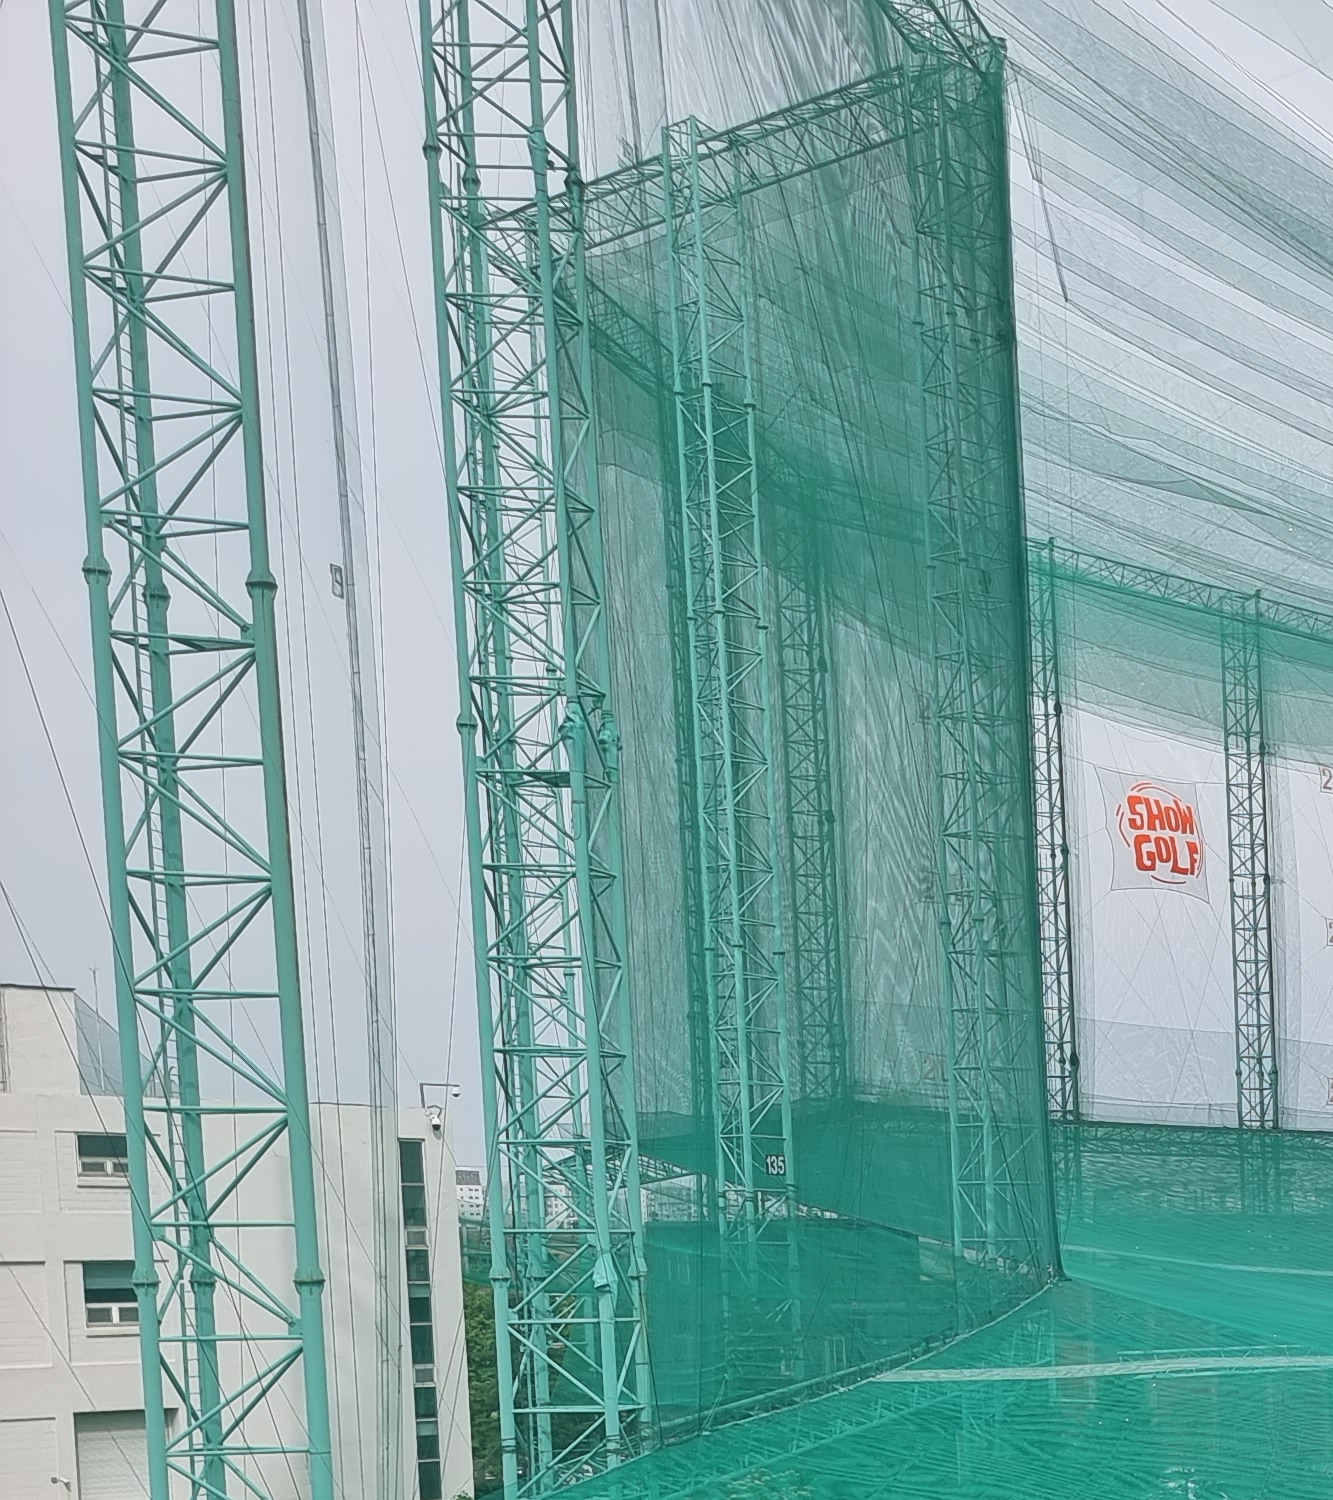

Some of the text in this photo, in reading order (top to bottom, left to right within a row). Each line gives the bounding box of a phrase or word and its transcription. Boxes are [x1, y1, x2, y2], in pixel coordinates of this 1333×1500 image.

[1127, 795, 1195, 836] SHOW
[1133, 834, 1200, 876] GOLF
[766, 1156, 786, 1175] 135
